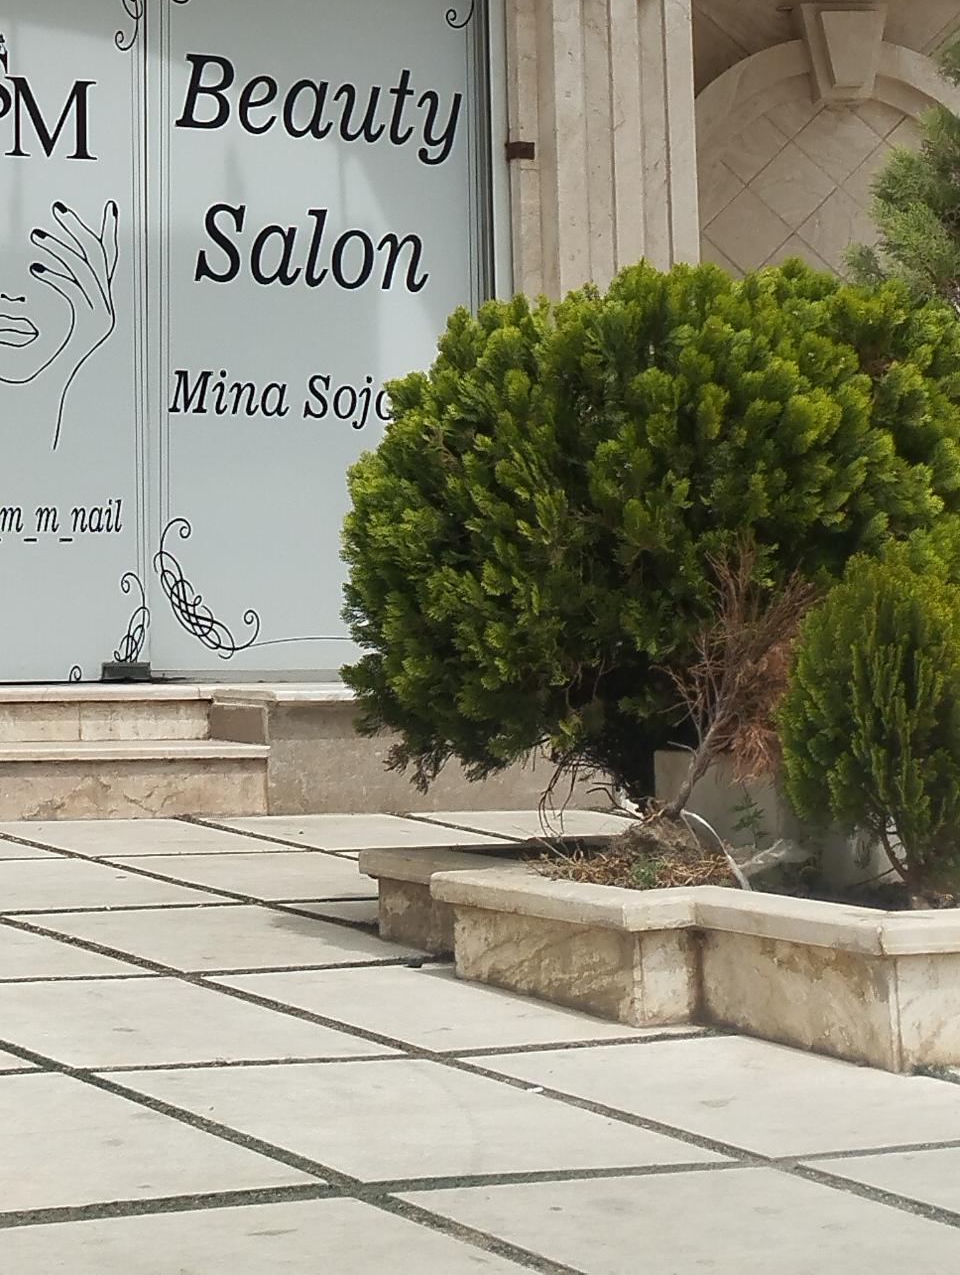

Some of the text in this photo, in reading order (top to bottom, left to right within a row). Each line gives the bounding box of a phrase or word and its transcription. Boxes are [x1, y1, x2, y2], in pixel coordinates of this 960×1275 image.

[175, 53, 463, 165] Beauty
[194, 203, 429, 293] Salon
[168, 369, 395, 430] Mina Sojo
